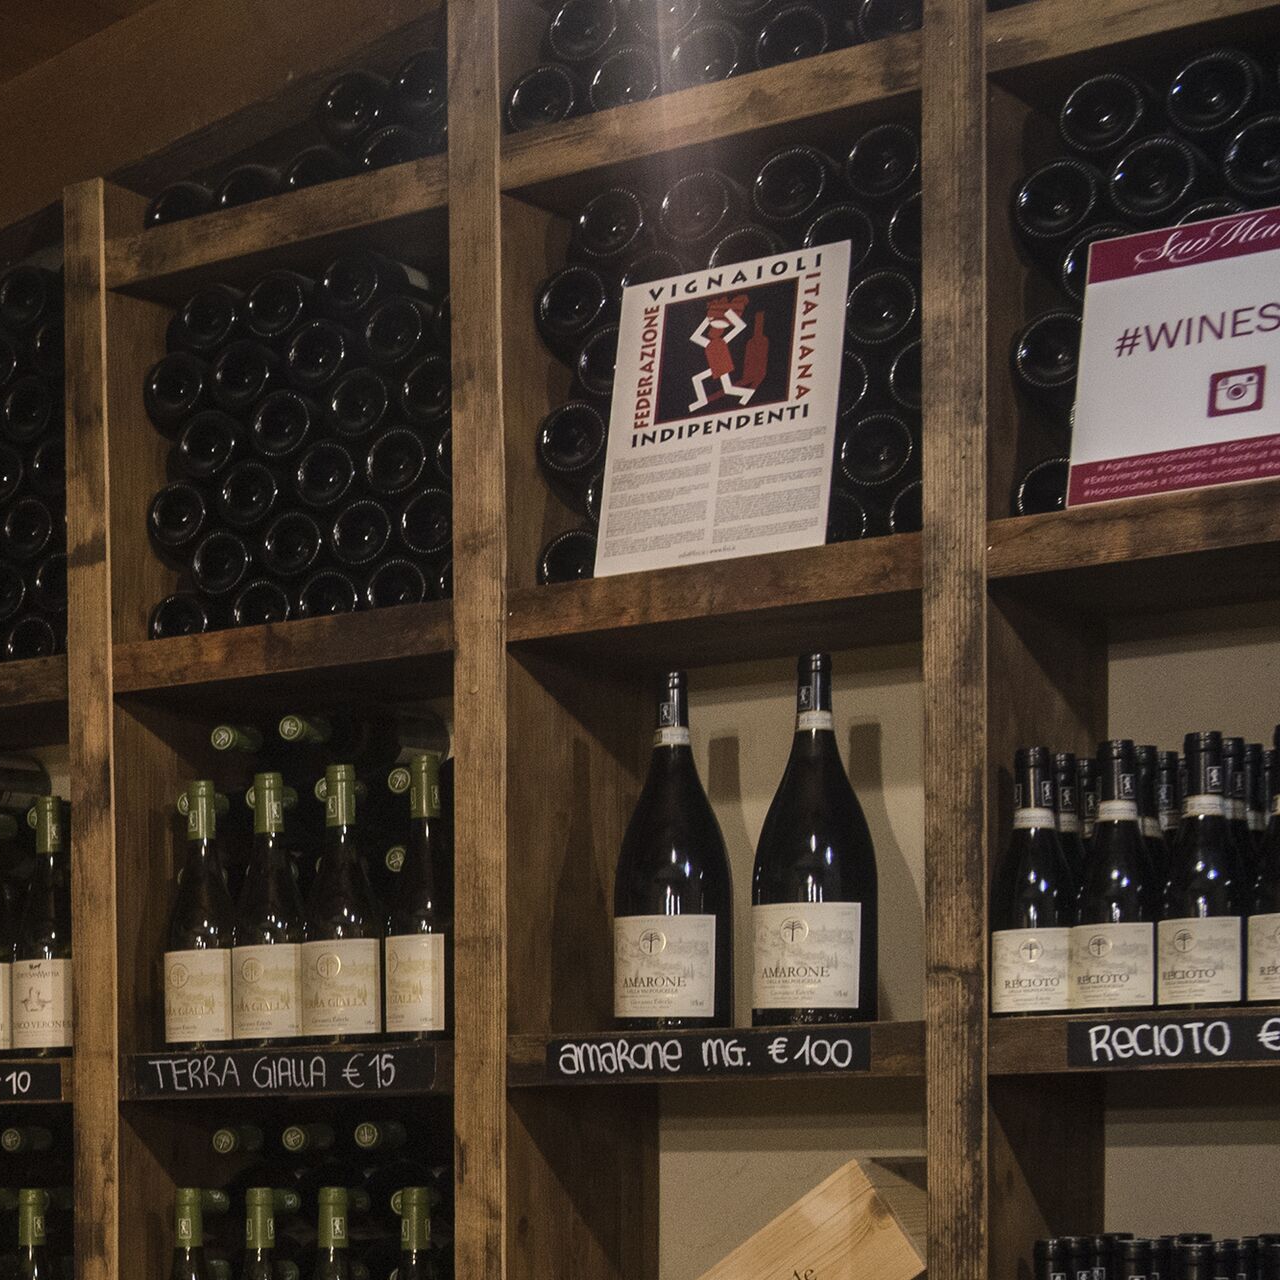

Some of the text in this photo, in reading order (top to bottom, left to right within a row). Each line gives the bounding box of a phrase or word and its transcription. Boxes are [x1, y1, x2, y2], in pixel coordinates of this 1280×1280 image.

[648, 253, 822, 301] VIGNAIOLI
[795, 271, 821, 400] ITALIANA
[633, 304, 660, 430] FEDERAZIONE
[631, 403, 810, 448] INDIPENDENTI
[622, 974, 687, 990] AMARONE
[761, 965, 831, 980] AMARONE
[1004, 977, 1061, 989] RECIOTO
[1077, 973, 1130, 985] RECIOTO
[1162, 968, 1217, 981] RECIOTO
[148, 1055, 241, 1092] TERRA
[252, 1055, 327, 1090] GIALLA
